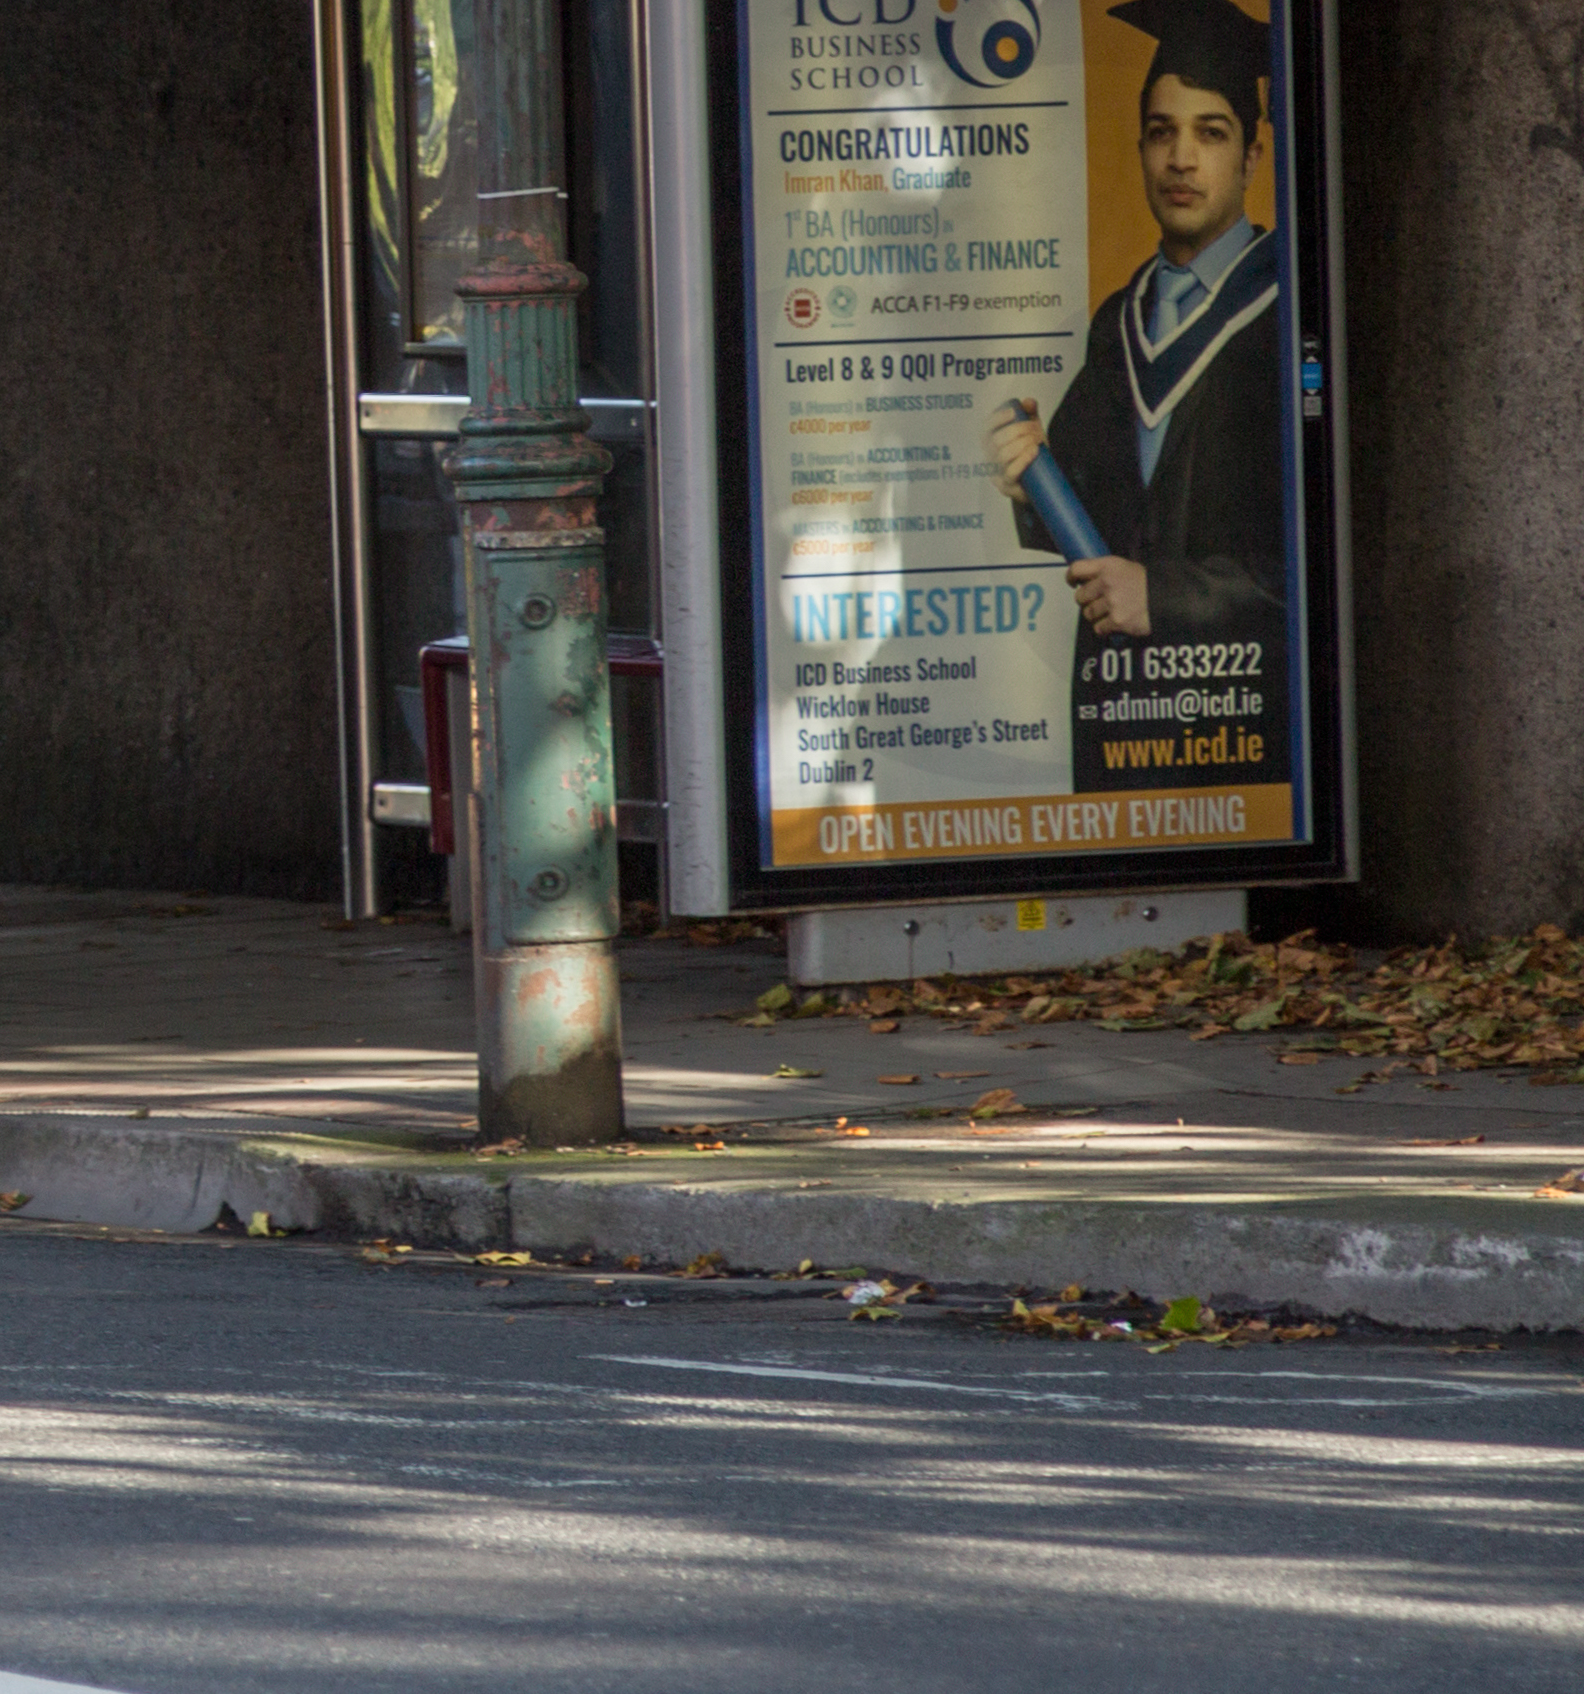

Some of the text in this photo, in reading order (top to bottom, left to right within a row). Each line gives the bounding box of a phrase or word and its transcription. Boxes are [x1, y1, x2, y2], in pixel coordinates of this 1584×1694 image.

[790, 33, 921, 59] BUSINESS
[790, 65, 924, 91] SCHOOL
[781, 123, 1030, 163] CONGRATULATIONS
[785, 167, 971, 194] Imran Khan, Graduate
[806, 210, 834, 239] BA
[841, 207, 939, 241] (Honours)
[786, 239, 1061, 278] ACCOUNTING & FINANCE
[871, 291, 1061, 314] ACCA F1-F9 exemption
[786, 353, 1063, 383] Level 8 & 9 QQI Programmes
[866, 395, 923, 412] BUSINESS
[926, 393, 973, 409] STUDIES
[828, 420, 846, 434] per
[847, 420, 871, 434] year
[867, 446, 939, 463] ACCOUNTING
[791, 469, 837, 486] FINANCE
[849, 490, 873, 504] year
[853, 516, 925, 534] ACCOUNTING
[938, 514, 984, 530] FINANCE
[793, 583, 1044, 642] INTERESTED?
[796, 656, 977, 687] ICD Business School
[1101, 642, 1262, 682] 01 6333222
[797, 692, 930, 719] Wicklow House
[1102, 686, 1263, 722] admin@icd.ie
[798, 728, 849, 752] South
[855, 726, 904, 749] Great
[993, 719, 1048, 742] Street
[1103, 725, 1264, 770] www.icd.ie
[799, 758, 874, 784] Dublin 2
[820, 796, 1246, 854] OPEN EVENING EVERY EVENING
